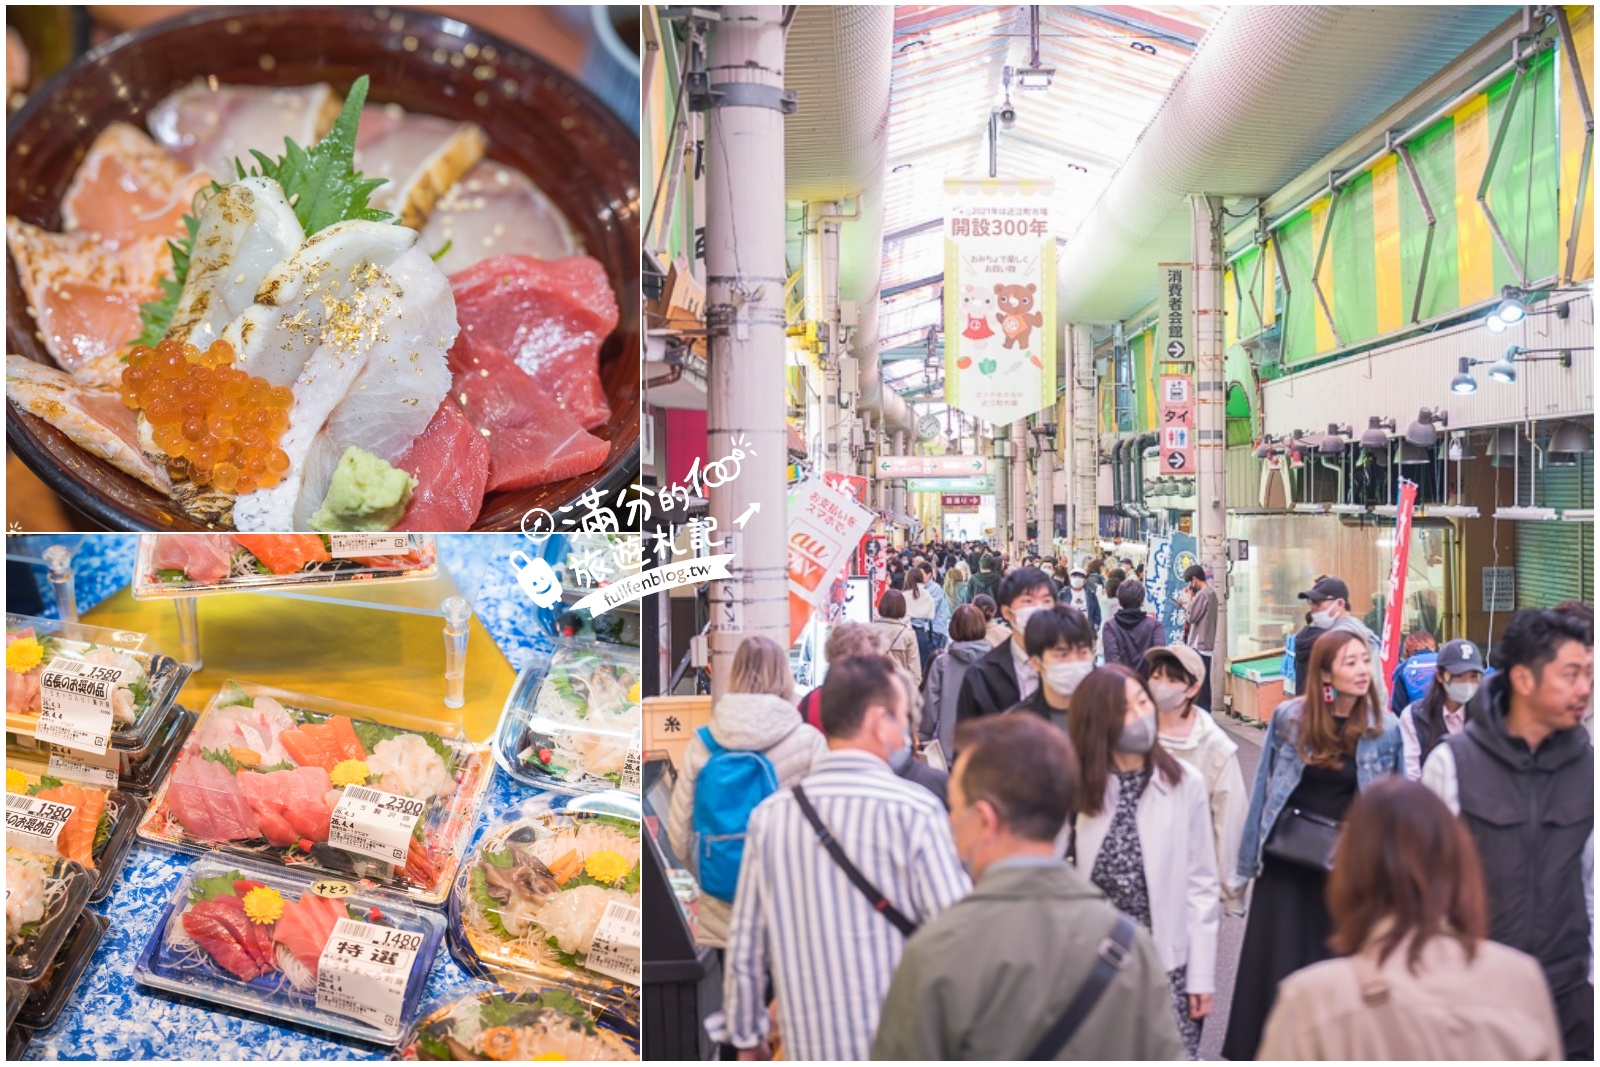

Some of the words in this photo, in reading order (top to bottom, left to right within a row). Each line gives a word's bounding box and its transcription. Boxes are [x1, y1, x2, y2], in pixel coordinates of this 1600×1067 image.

[951, 218, 1048, 238] 開設300年
[1168, 269, 1183, 338] 消費者会館
[809, 491, 858, 528] お支払いを
[791, 532, 829, 558] au
[1460, 644, 1473, 660] P
[89, 666, 122, 680] 1580
[44, 673, 105, 698] 店長のお奨め品
[38, 802, 73, 819] 1580
[386, 796, 423, 814] 2300
[331, 818, 354, 828] 26.4.4
[317, 883, 349, 894] 中とろ
[383, 930, 421, 948] 1480
[337, 941, 400, 966] 特選
